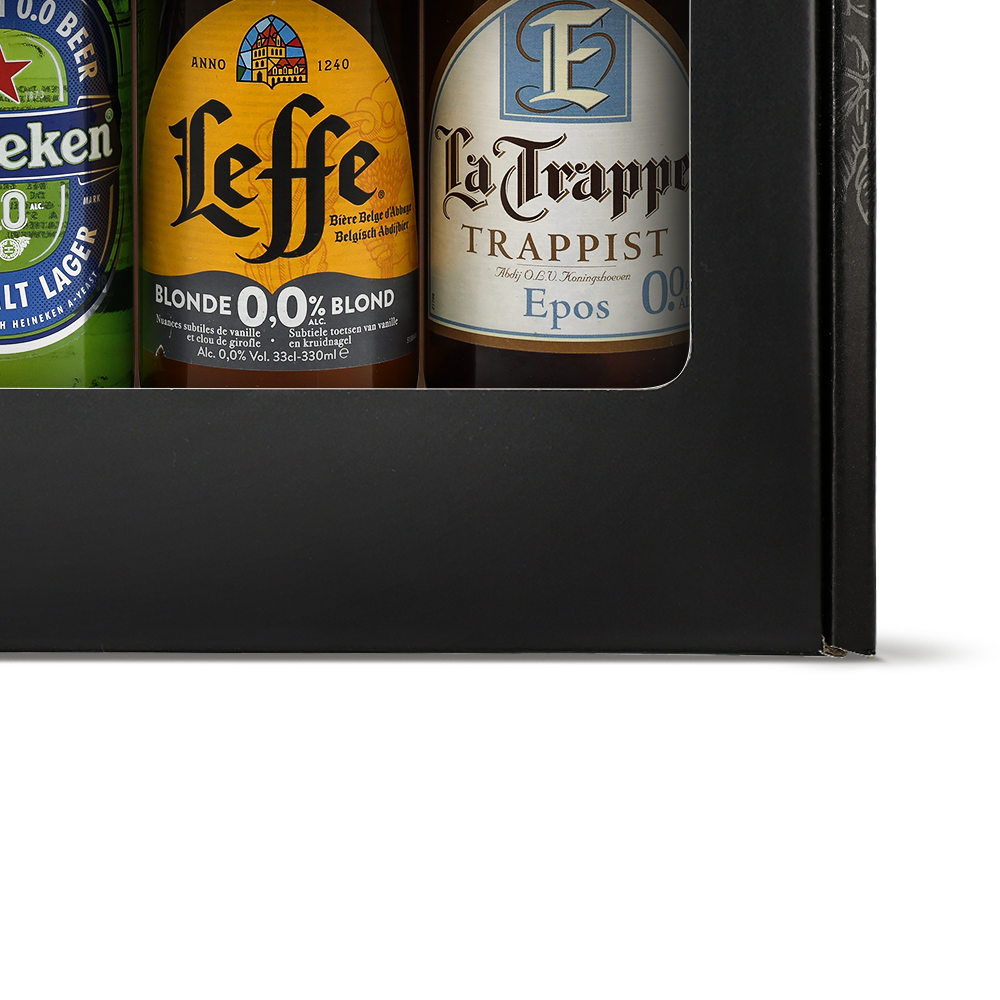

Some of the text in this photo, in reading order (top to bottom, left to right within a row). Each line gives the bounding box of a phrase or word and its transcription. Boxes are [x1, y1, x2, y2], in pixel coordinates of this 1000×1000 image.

[56, 11, 98, 82] BEER
[191, 56, 350, 71] ANNO 1240
[529, 7, 612, 113] E
[25, 91, 45, 99] 1873
[169, 93, 380, 264] Leffe
[435, 126, 690, 224] La Trappe
[83, 195, 101, 205] MARK
[329, 214, 357, 226] Bière
[359, 209, 383, 223] Belge
[335, 227, 376, 243] Belgisch
[461, 224, 669, 262] TRAPPIST
[39, 226, 97, 299] LAGER
[494, 266, 522, 282] Abdij
[559, 270, 631, 285] Koningshoeven
[13, 305, 64, 329] HEINEKEN
[67, 271, 98, 308] A-YEAST
[155, 283, 232, 315] BLONDE
[331, 289, 395, 315] BLOND
[642, 266, 689, 314] 0.0
[523, 288, 610, 330] Epos
[679, 295, 690, 309] AL
[156, 313, 261, 338] Nuances subtiles de vanille
[288, 317, 399, 338] Subtiele toetsen van vanille
[308, 318, 326, 326] ALC.
[186, 334, 261, 349] et clou de girofle
[303, 335, 352, 348] kruidnagel
[197, 346, 216, 358] Alc.
[218, 349, 247, 362] 0,0%
[249, 351, 270, 362] Vol.
[273, 349, 337, 362] 33cl-330ml
